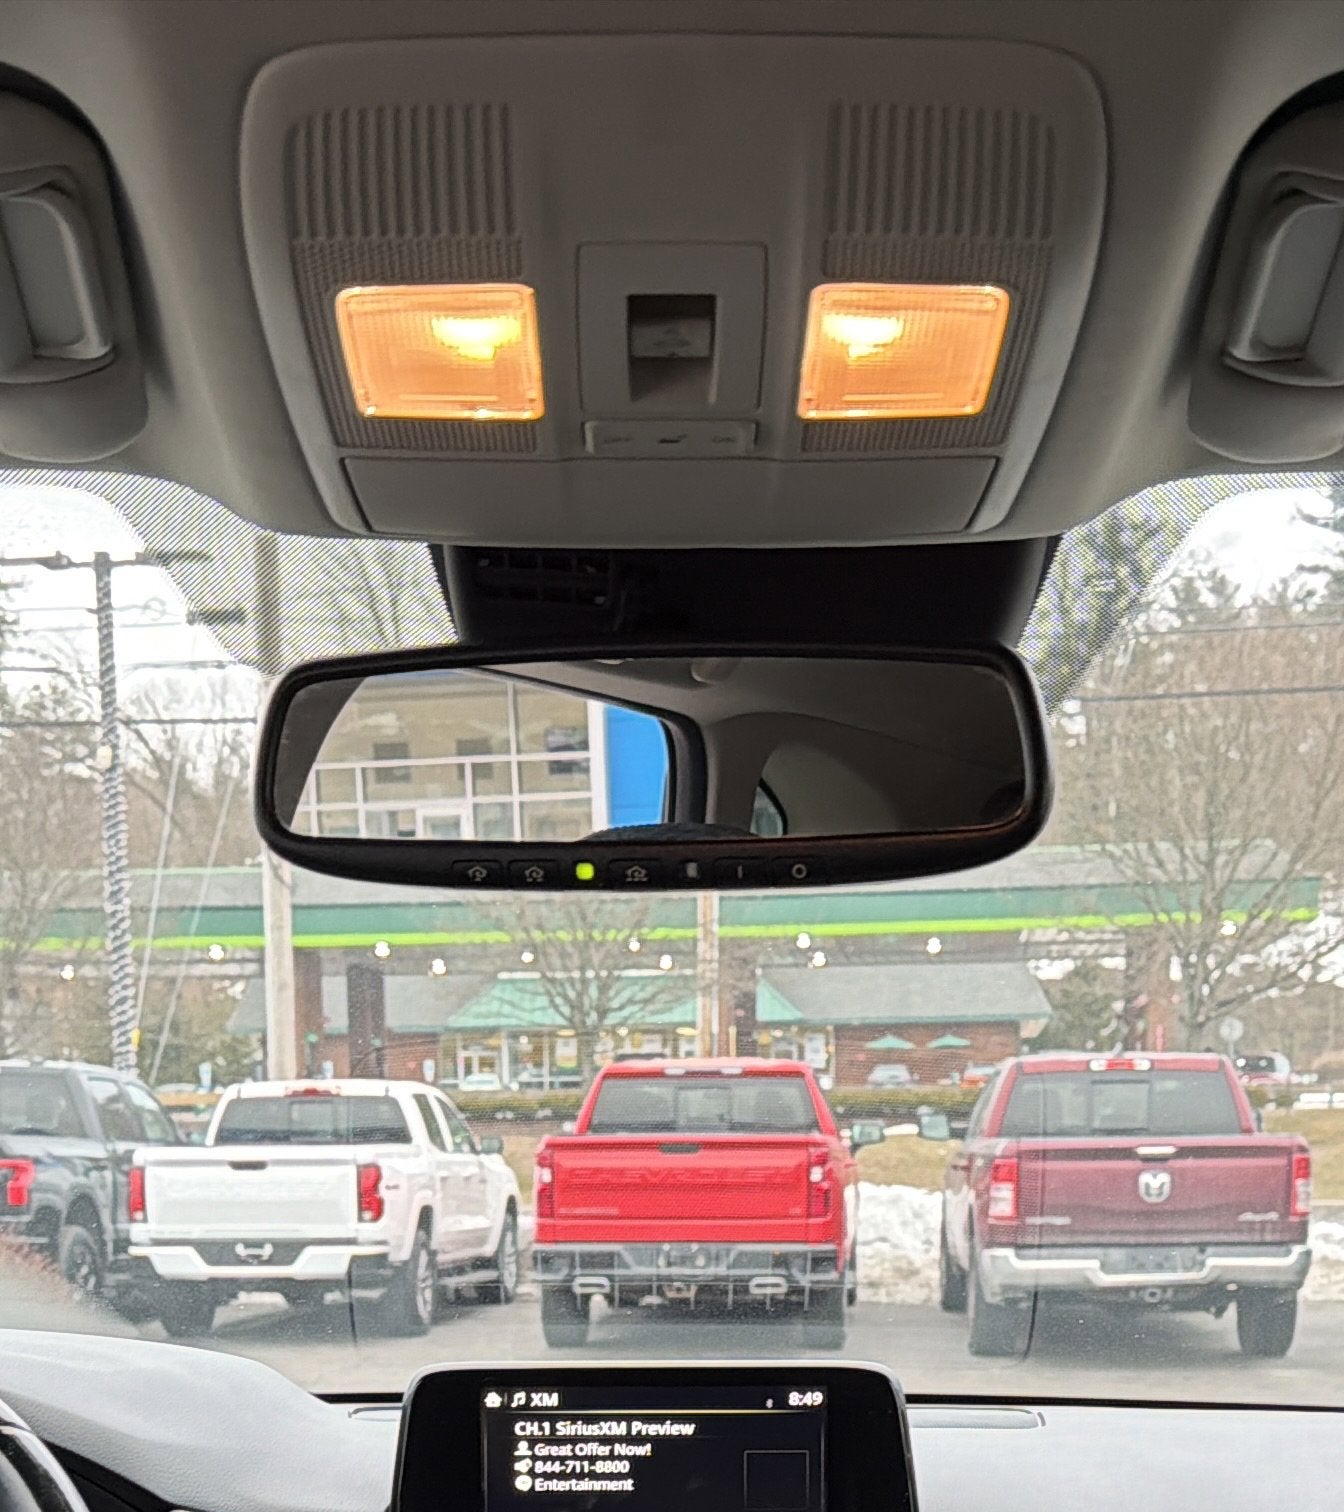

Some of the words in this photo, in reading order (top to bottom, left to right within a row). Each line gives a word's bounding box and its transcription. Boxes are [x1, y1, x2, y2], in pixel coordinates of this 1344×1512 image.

[530, 1392, 559, 1407] XM
[787, 1391, 824, 1407] 8:49
[514, 1421, 551, 1437] CH.1
[556, 1420, 627, 1436] SiriusXM
[631, 1420, 695, 1436] Preview
[534, 1442, 572, 1458] Great
[575, 1442, 612, 1457] Offer
[614, 1442, 651, 1457] Now!
[534, 1459, 630, 1475] 844-711-8800
[534, 1476, 634, 1492] Entertainment
